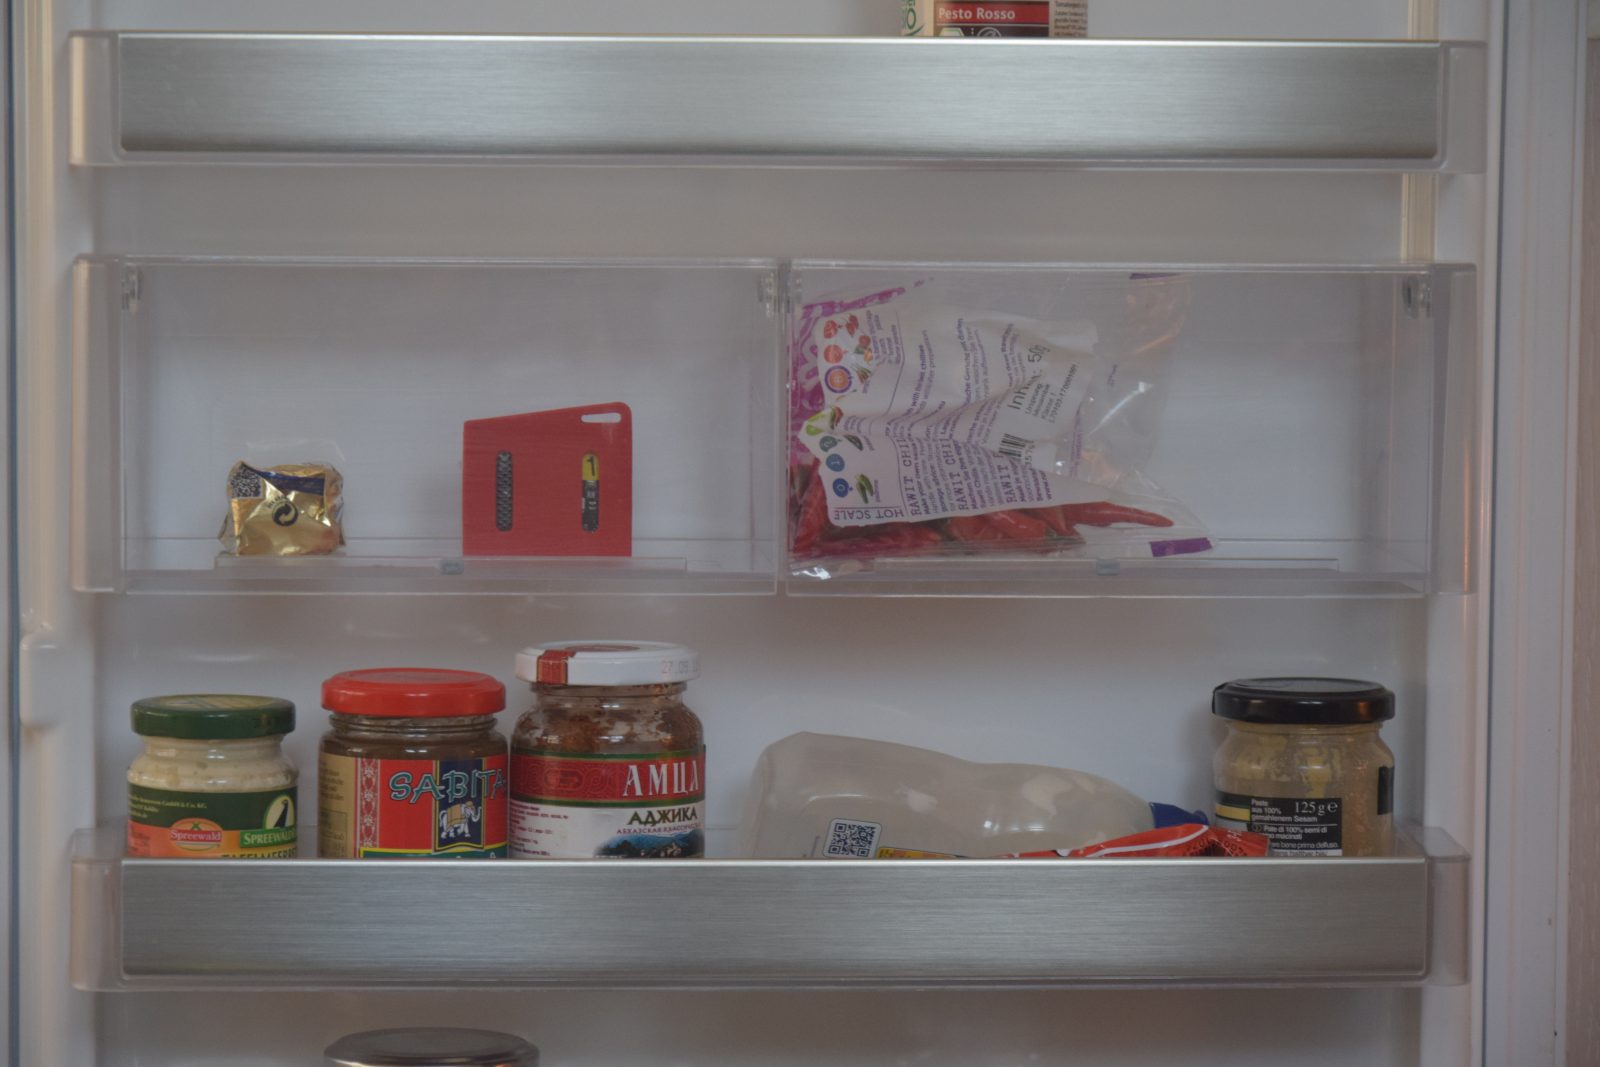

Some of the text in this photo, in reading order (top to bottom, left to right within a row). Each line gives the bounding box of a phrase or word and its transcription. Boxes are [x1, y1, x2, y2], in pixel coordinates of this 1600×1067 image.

[938, 8, 1016, 20] Pesto Rosso
[949, 472, 968, 511] RAWIT
[997, 465, 1017, 504] RAWIT
[903, 476, 922, 517] RAWIT
[834, 508, 904, 521] HOT SCALE
[389, 768, 506, 804] SABITA
[1264, 807, 1282, 815] 100%
[1295, 801, 1316, 813] 125
[1318, 803, 1325, 816] g
[627, 806, 698, 826] АДЖИКА
[1294, 815, 1317, 823] Sesam
[170, 830, 221, 842] Spreewald
[1286, 826, 1303, 834] 100%
